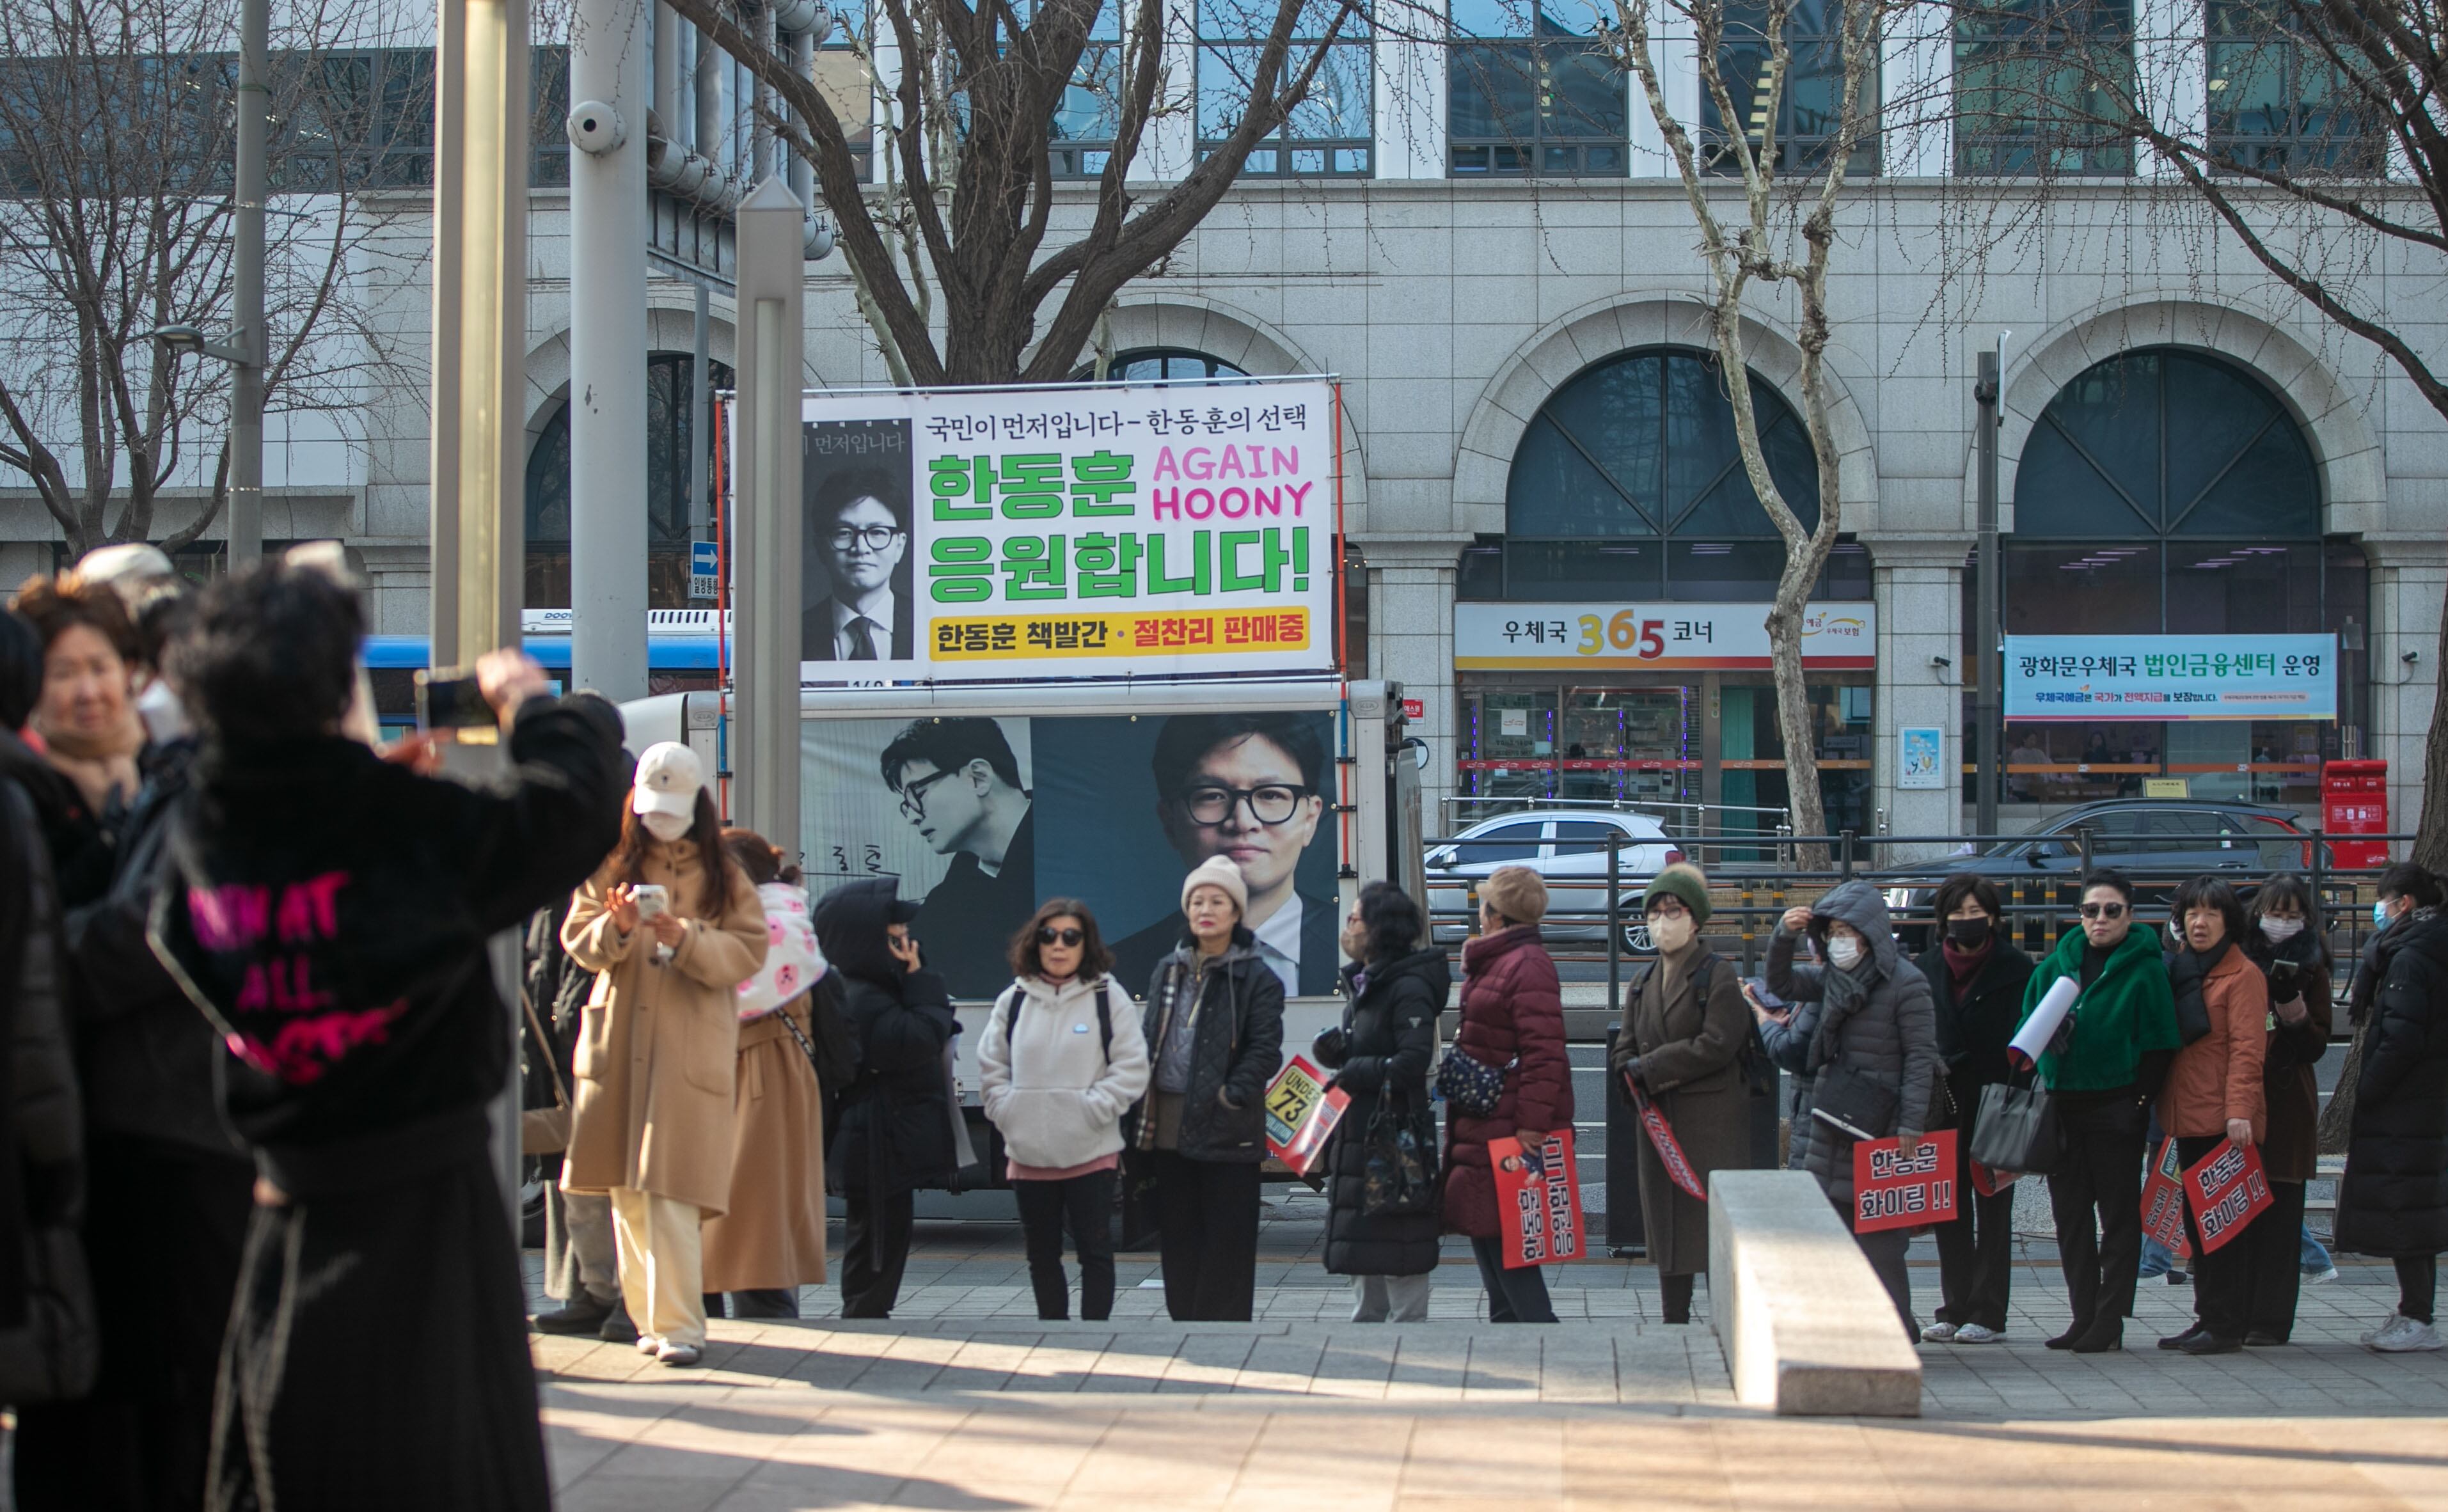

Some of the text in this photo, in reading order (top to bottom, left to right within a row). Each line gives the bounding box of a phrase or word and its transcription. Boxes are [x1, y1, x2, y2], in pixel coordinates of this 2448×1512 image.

[926, 414, 995, 443] 국민이
[1257, 404, 1306, 431] 선택
[814, 432, 906, 455] 먼저입니다
[1153, 444, 1298, 482] AGAIN
[929, 450, 1136, 521] 한동훈
[1153, 481, 1313, 521] HOONY
[929, 526, 1309, 602] 응원합니다!
[938, 622, 1016, 652] 한동훈
[1027, 620, 1108, 649] 책발간
[1134, 617, 1213, 647] 절찬리
[1224, 614, 1304, 643] 판매중
[1502, 608, 1712, 661] 우체국 365 코너
[2019, 653, 2320, 677] 광화문우체국 법인금융센터 운영
[1272, 1088, 1308, 1122] 73
[1870, 1142, 1937, 1179] 한동훈
[2198, 1144, 2246, 1199] 한동훈
[1542, 1135, 1575, 1256] 응원합니다
[1860, 1183, 1925, 1220] 화이팅
[2199, 1182, 2250, 1240] 화이팅
[1518, 1187, 1546, 1263] 한동훈
